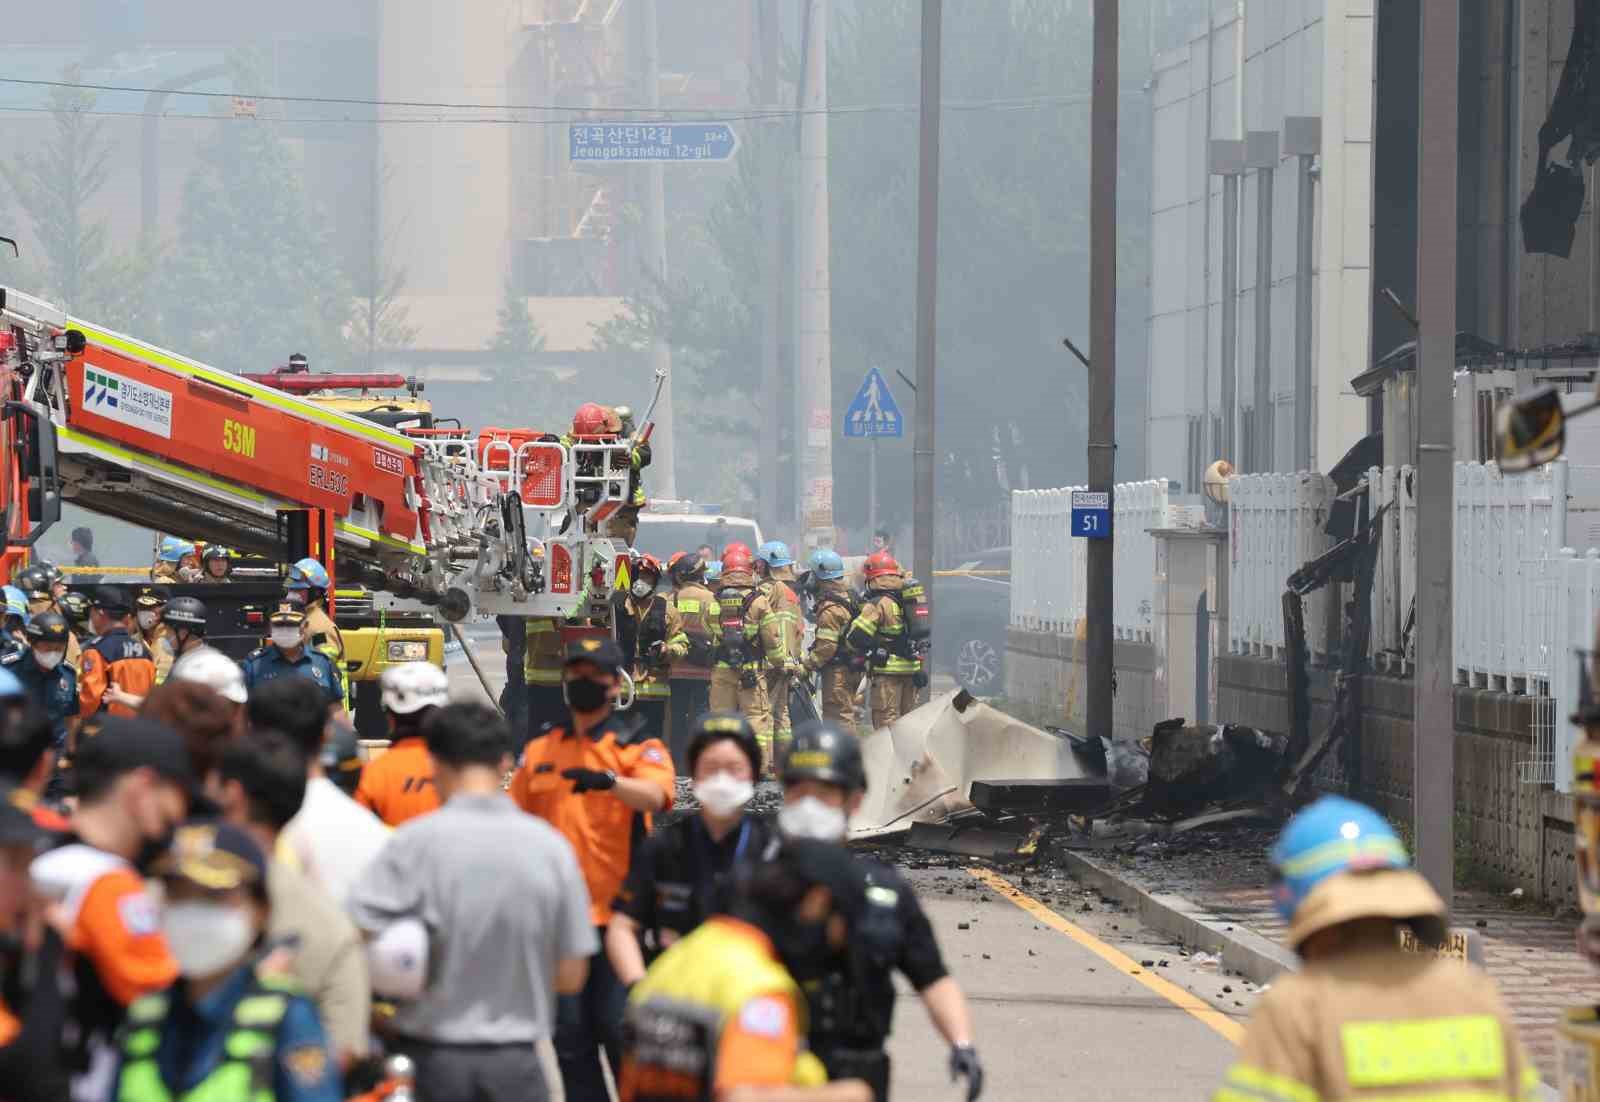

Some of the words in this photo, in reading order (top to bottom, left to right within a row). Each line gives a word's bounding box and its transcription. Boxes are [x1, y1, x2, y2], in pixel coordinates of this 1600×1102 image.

[574, 127, 673, 145] 전곡산단12길
[676, 144, 712, 160] 12-gil
[224, 414, 256, 458] 53M
[1083, 515, 1098, 531] 51
[123, 642, 143, 657] 119
